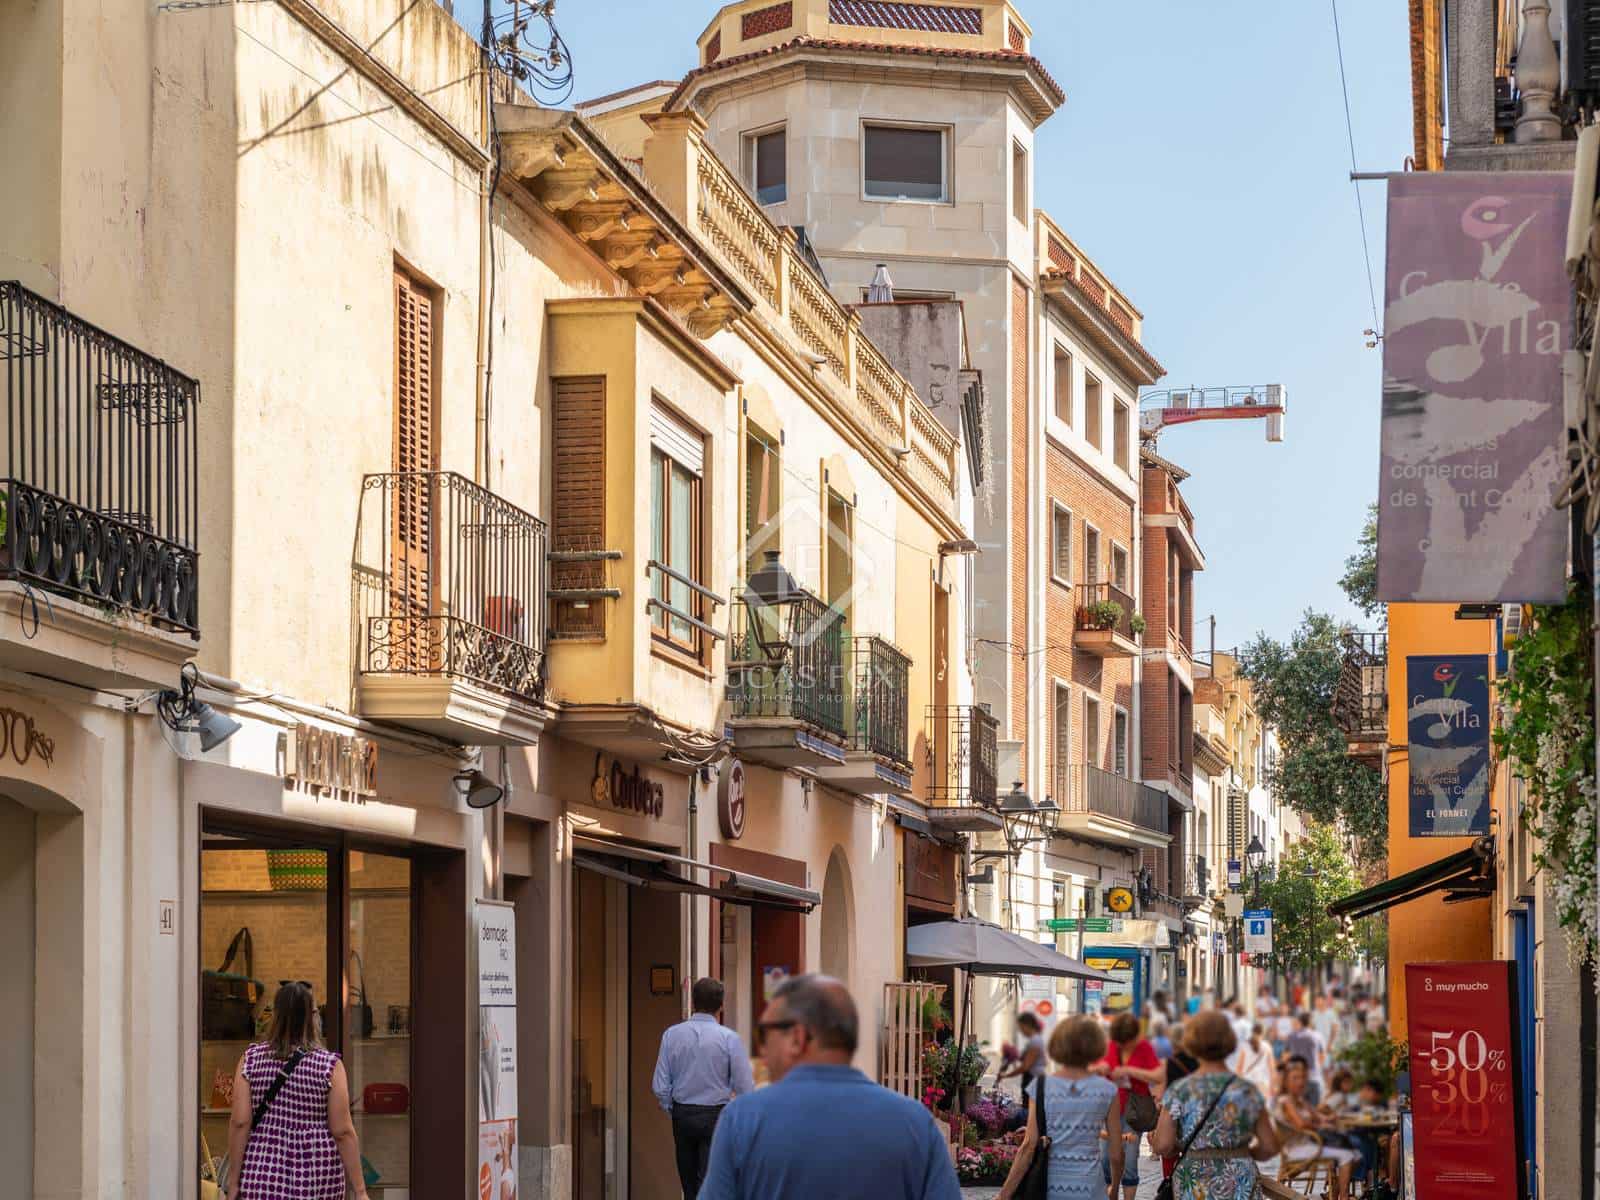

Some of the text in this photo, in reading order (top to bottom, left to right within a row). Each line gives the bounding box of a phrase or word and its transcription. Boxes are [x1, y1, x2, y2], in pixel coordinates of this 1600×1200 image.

[1390, 459, 1500, 480] comercial
[1389, 489, 1418, 507] de
[1424, 488, 1477, 507] Snt
[160, 906, 172, 929] 41
[1436, 982, 1489, 993] muy mucho
[1418, 1030, 1506, 1071] -50%
